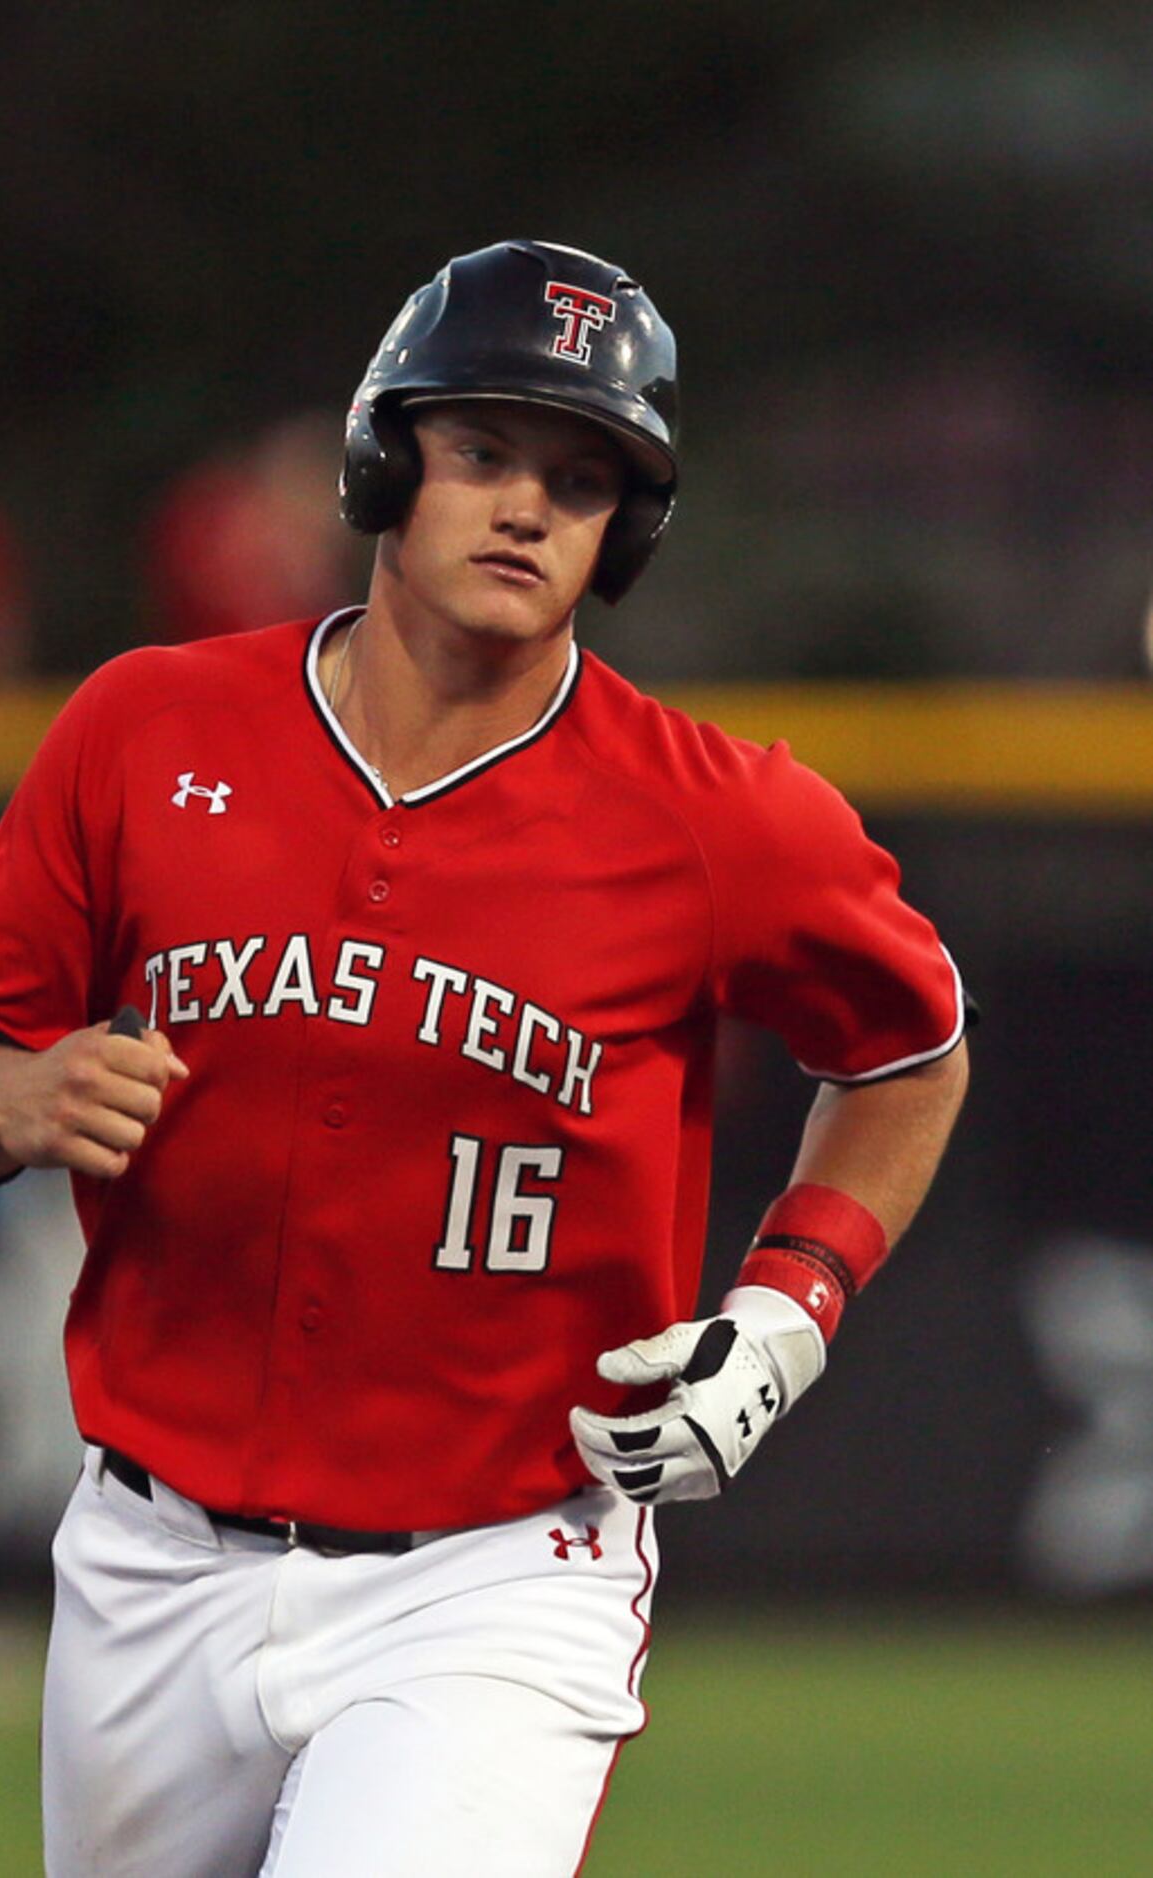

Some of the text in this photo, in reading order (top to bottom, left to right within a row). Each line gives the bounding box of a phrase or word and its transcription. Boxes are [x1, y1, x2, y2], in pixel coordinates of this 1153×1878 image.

[144, 934, 603, 1115] TEXAS TECH
[433, 1133, 565, 1273] 16
